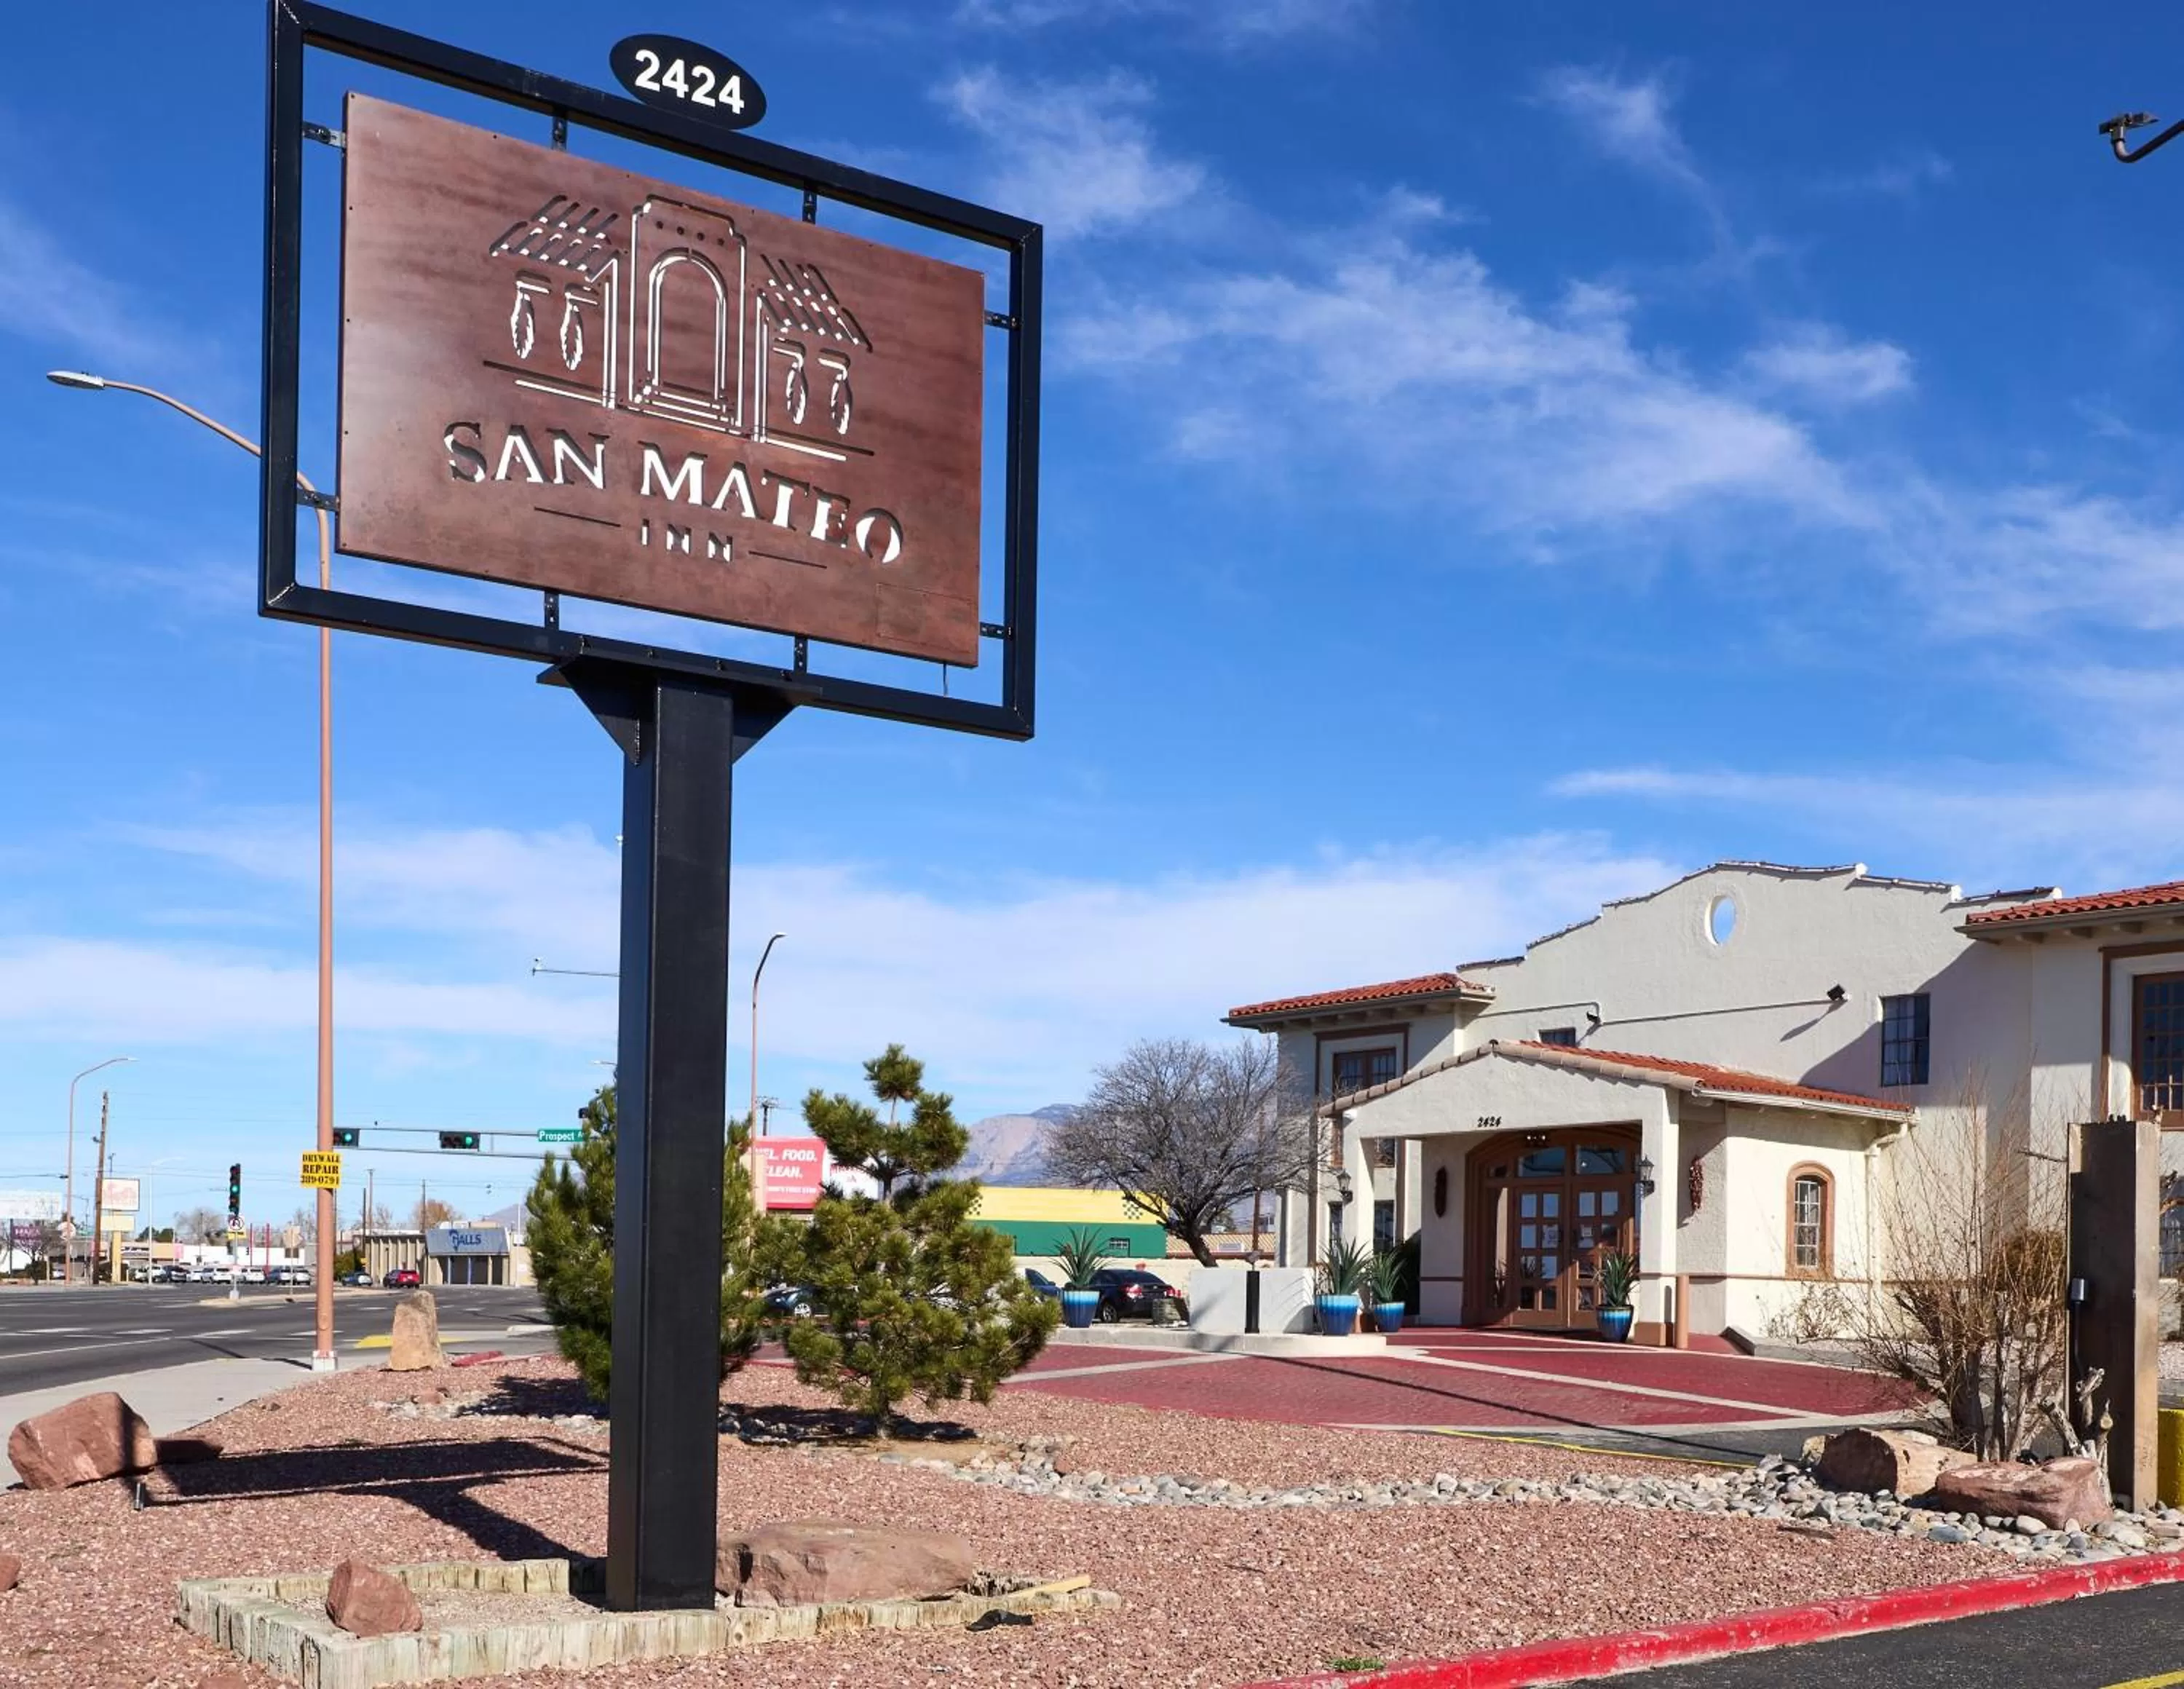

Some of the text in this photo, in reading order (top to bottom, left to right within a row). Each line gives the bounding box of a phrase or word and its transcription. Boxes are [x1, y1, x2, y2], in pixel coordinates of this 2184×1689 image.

[635, 49, 744, 114] 2424
[443, 422, 903, 564] SAN MATEO
[640, 518, 732, 562] INN
[1477, 1116, 1501, 1128] 2424
[539, 1131, 574, 1142] Prospect
[303, 1164, 339, 1174] REPAIR
